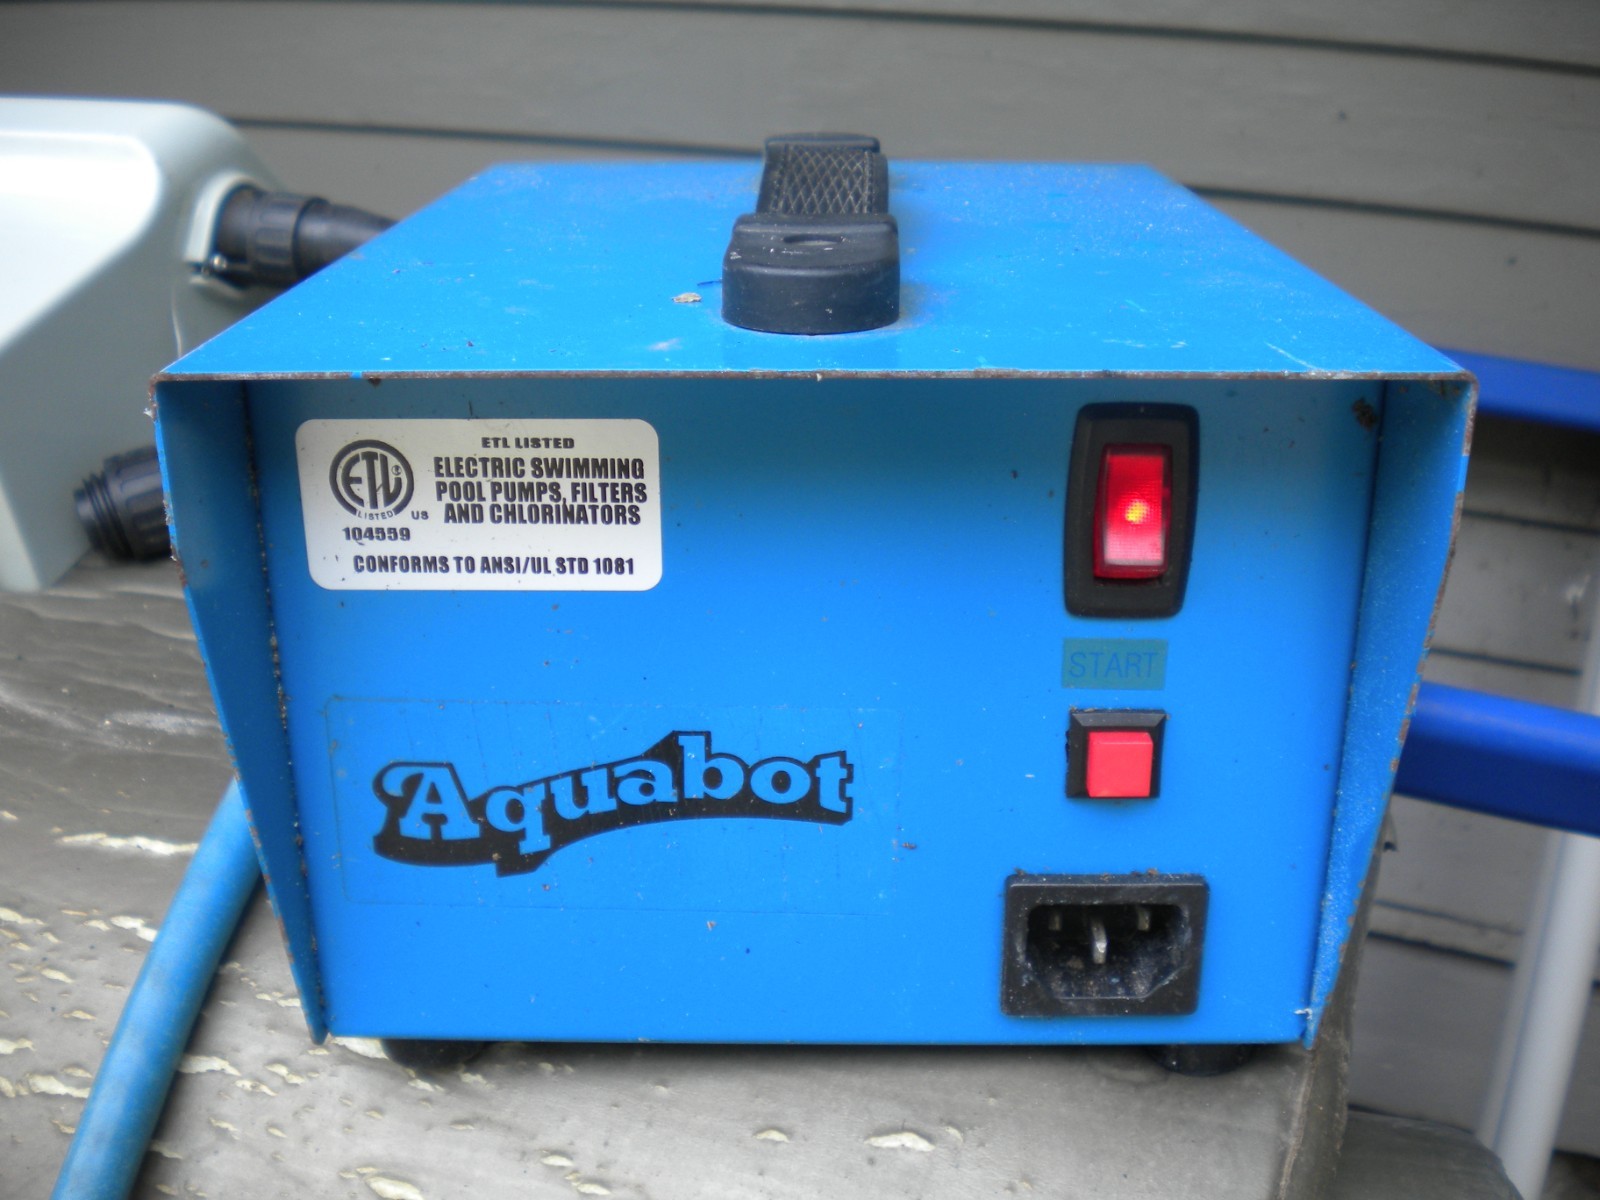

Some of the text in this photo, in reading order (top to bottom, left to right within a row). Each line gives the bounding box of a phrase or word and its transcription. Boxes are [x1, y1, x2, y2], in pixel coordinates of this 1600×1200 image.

[482, 437, 575, 449] ETL LISTED
[434, 456, 645, 480] ELECTRIC SWIMMING
[436, 481, 648, 505] POOL PUMPS, FILTERS
[356, 509, 394, 521] LISTED
[411, 511, 429, 521] US
[444, 503, 642, 525] AND CHLORINATORS
[342, 527, 411, 542] 104559
[353, 555, 634, 575] CONFORMS TO ANSI/UL STD 1081
[1069, 652, 1159, 679] START
[373, 730, 854, 877] Aquabot
